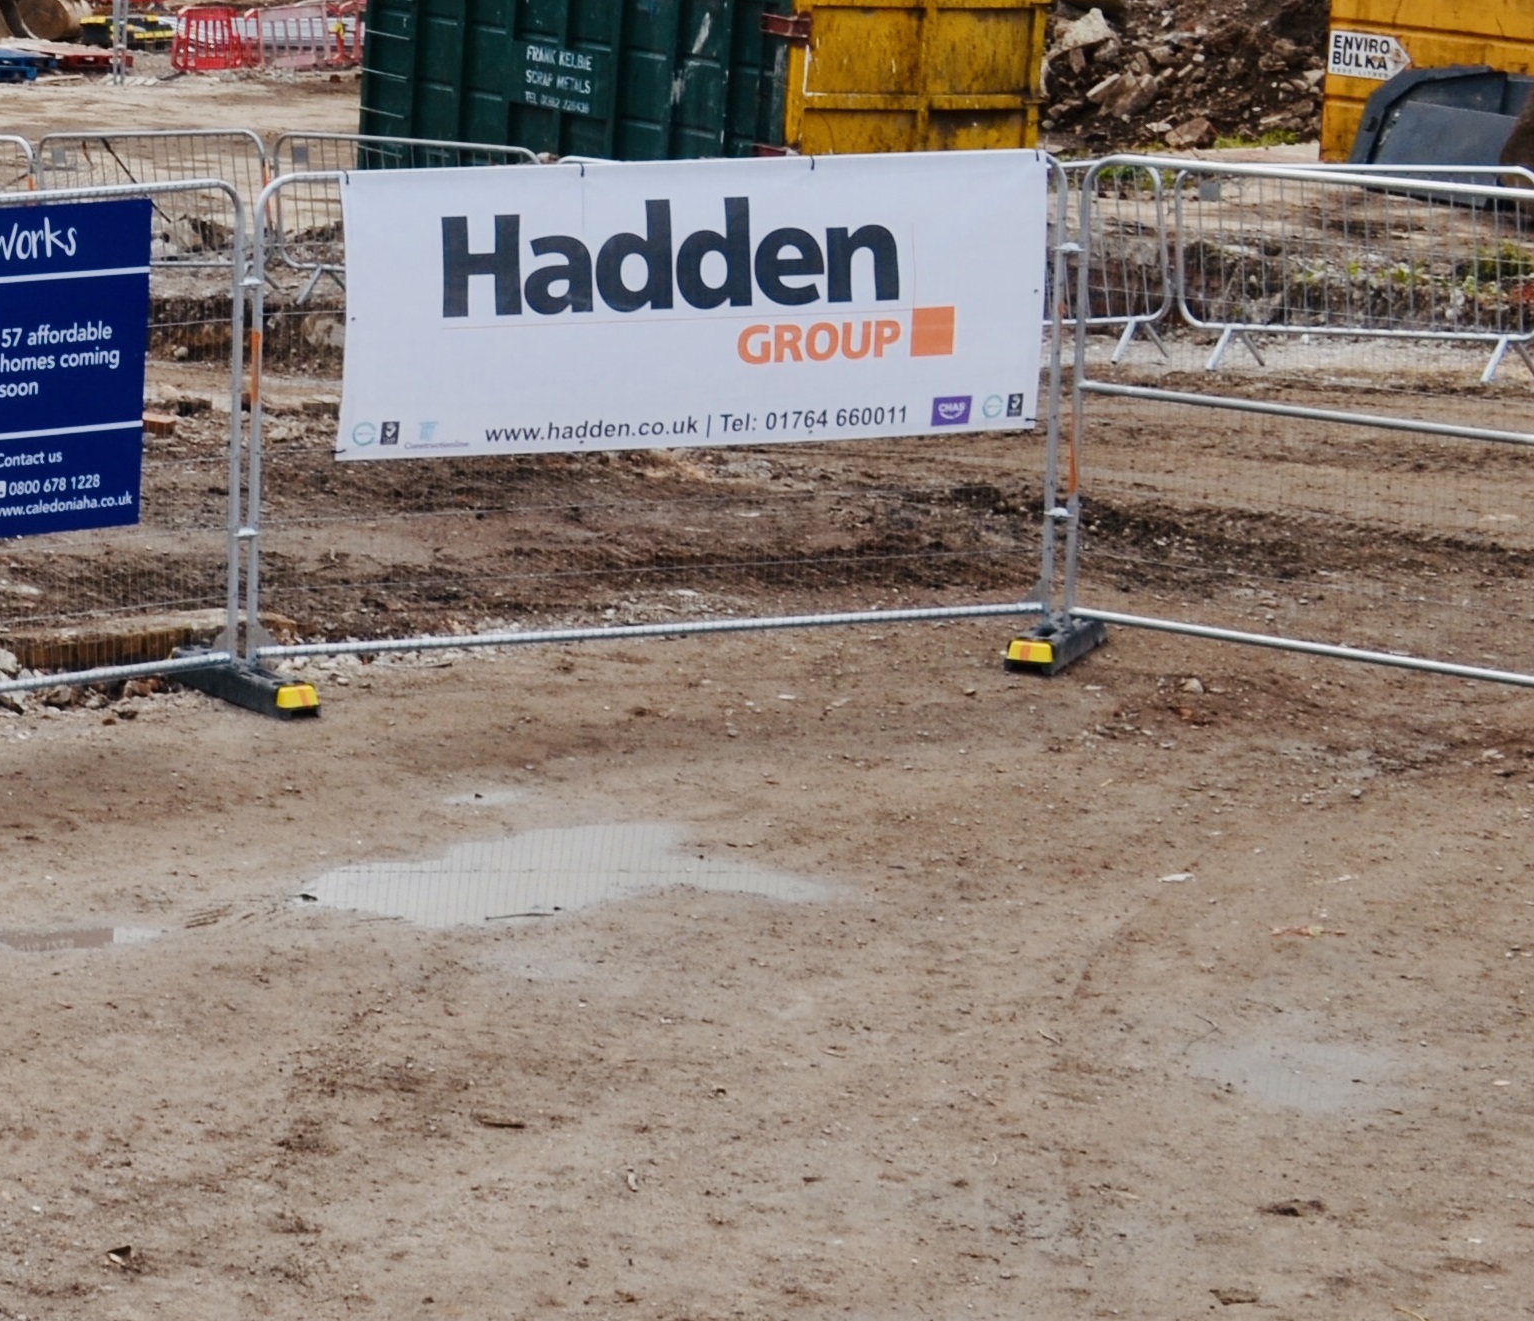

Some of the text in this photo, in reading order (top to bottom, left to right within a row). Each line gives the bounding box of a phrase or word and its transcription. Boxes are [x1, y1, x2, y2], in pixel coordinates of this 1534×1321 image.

[526, 45, 556, 65] FRANK
[1333, 34, 1390, 55] ENVIRO
[1332, 50, 1388, 71] BULKA
[556, 75, 591, 95] METALS
[442, 196, 900, 318] Hadden
[1, 320, 112, 348] 57 affordable
[737, 318, 900, 365] GROUP
[0, 346, 120, 373] homes coming
[938, 401, 966, 413] CHAS
[485, 415, 698, 443] www.hadden.co.uk
[720, 413, 758, 433] Tel:
[765, 409, 828, 432] 01764
[835, 405, 908, 428] 660011
[48, 451, 63, 464] us
[8, 473, 101, 496] 0800 678 1228
